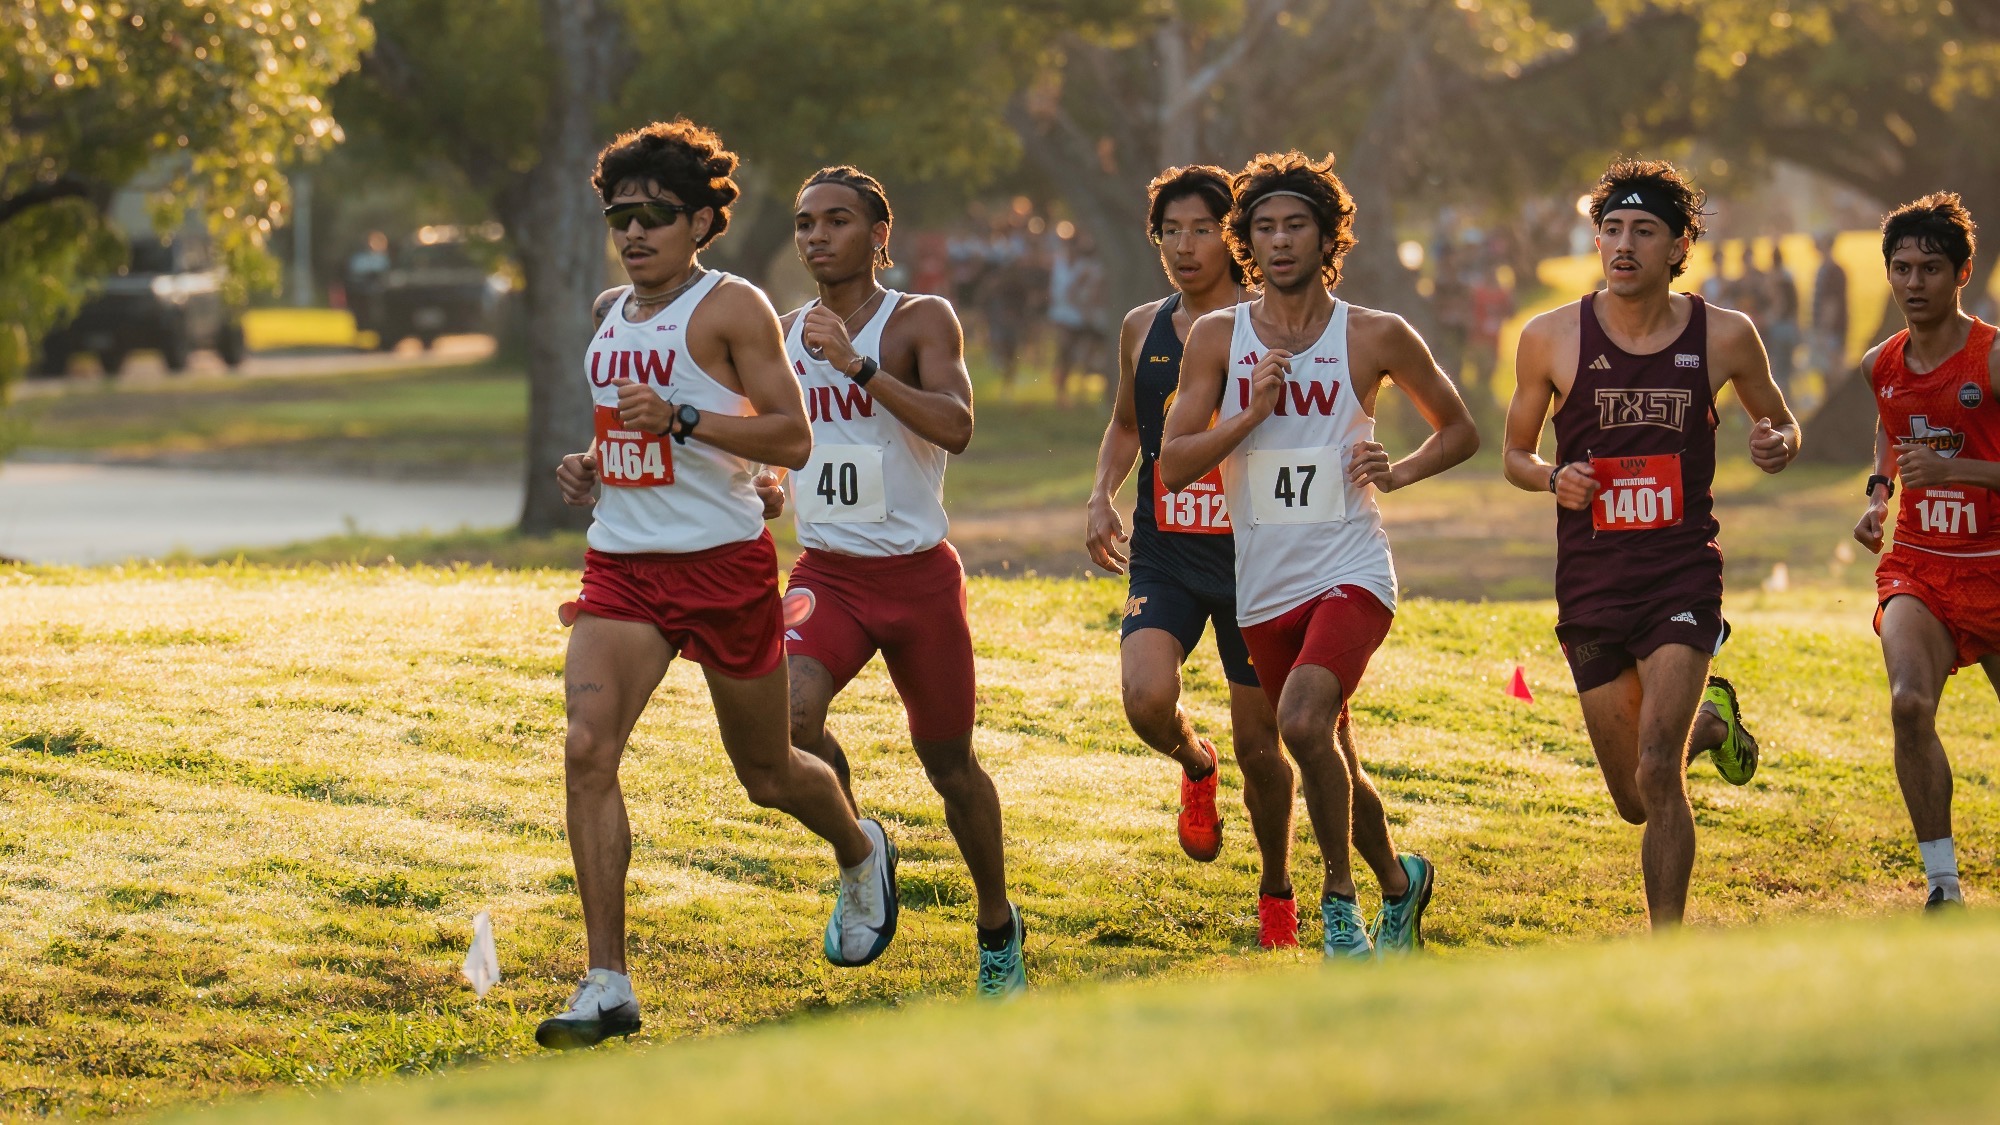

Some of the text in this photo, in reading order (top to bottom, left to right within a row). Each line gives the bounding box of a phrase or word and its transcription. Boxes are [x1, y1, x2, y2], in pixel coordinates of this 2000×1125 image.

[590, 349, 676, 388] UIW
[1599, 391, 1690, 428] TXST
[599, 441, 666, 480] 1464
[1620, 458, 1647, 469] UIW
[816, 462, 859, 505] 40
[1274, 465, 1317, 508] 47
[1613, 477, 1657, 487] INVITATIONAL
[1926, 489, 1965, 499] INVITATIONAL
[1161, 492, 1230, 528] 1312
[1600, 487, 1673, 524] 1401
[1916, 500, 1978, 534] 1471
[1670, 614, 1698, 626] adidas
